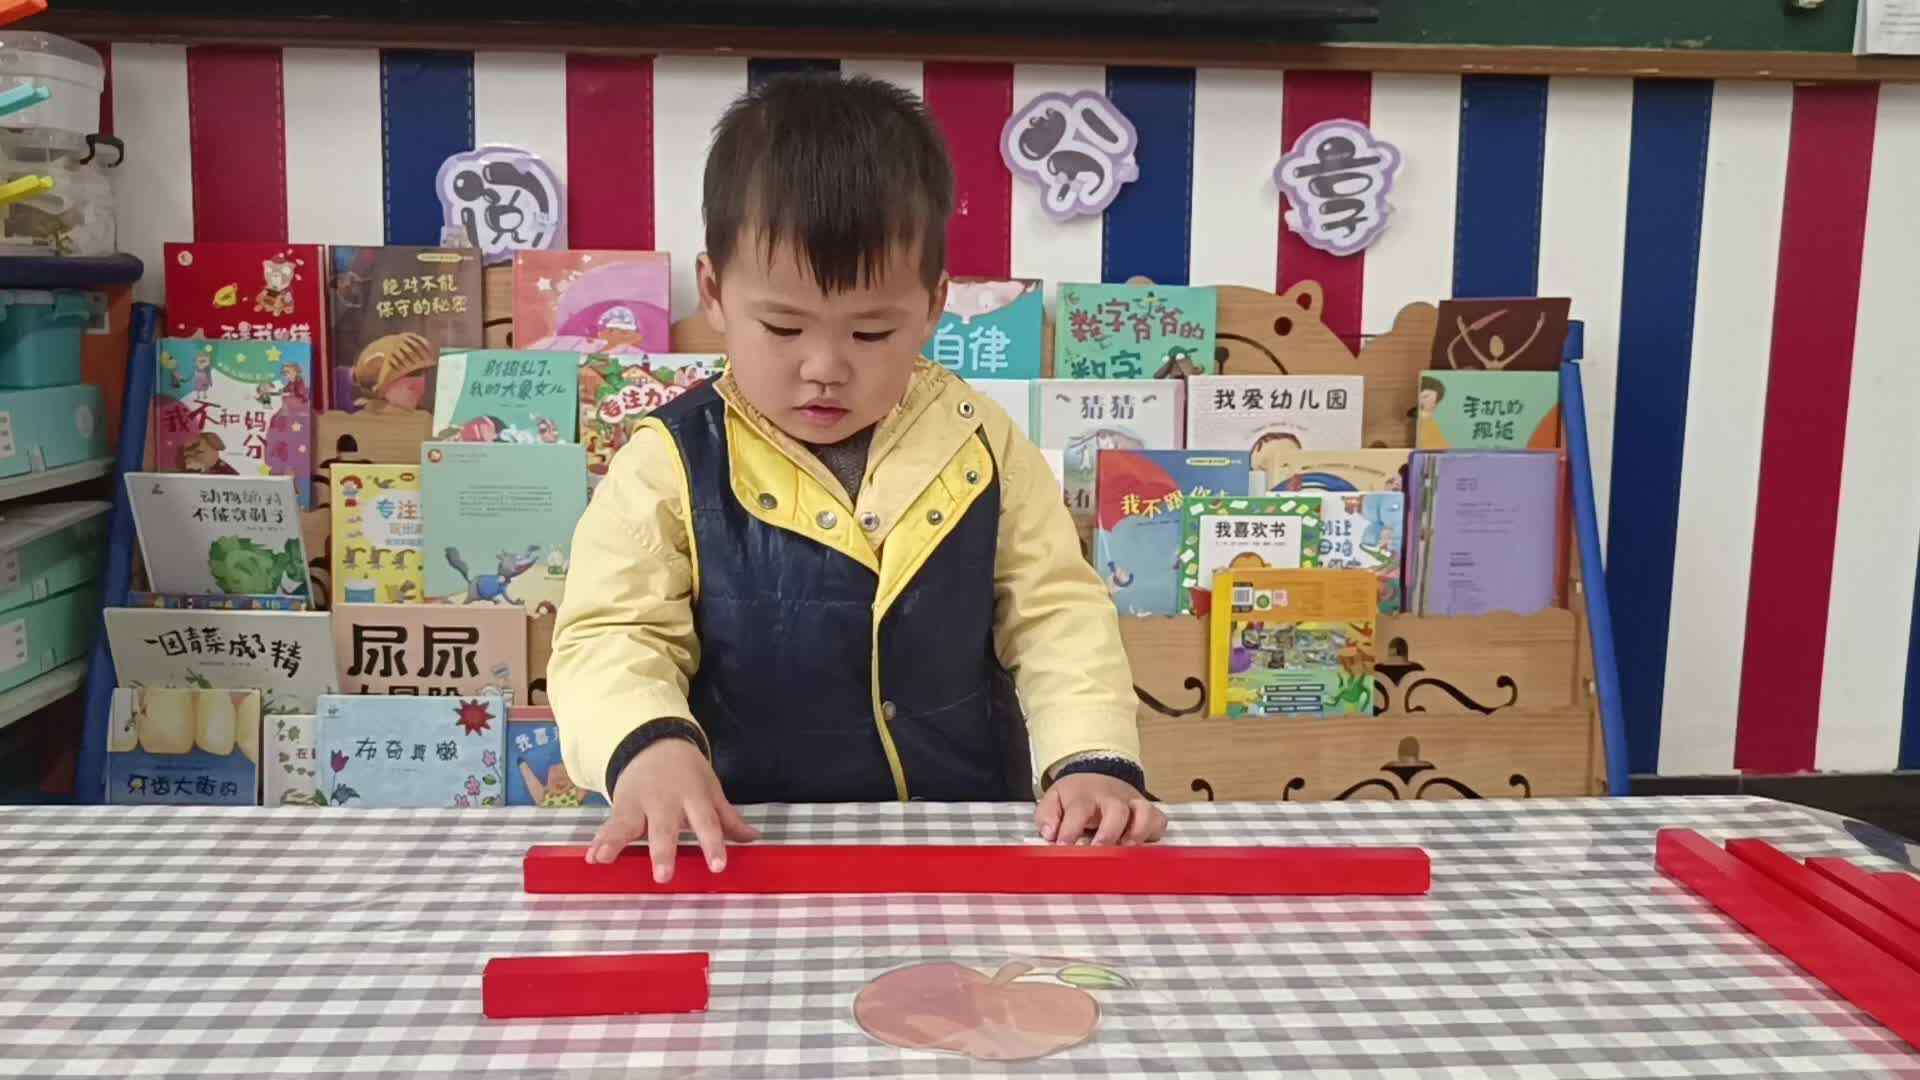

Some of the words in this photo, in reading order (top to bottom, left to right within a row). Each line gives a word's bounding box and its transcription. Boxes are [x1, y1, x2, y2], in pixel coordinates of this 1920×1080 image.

[1293, 136, 1381, 238] 享
[382, 273, 457, 296] 绝对不能
[376, 295, 468, 318] 保守的秘密
[1070, 298, 1205, 344] 数字爷爷的
[933, 323, 1011, 373] 自律
[1079, 394, 1134, 419] 猜猜
[1214, 388, 1347, 410] 我爱幼儿园
[1463, 395, 1525, 418] 手机的
[376, 498, 424, 519] 专注
[1215, 521, 1286, 538] 我喜欢书
[347, 623, 480, 679] 尿尿
